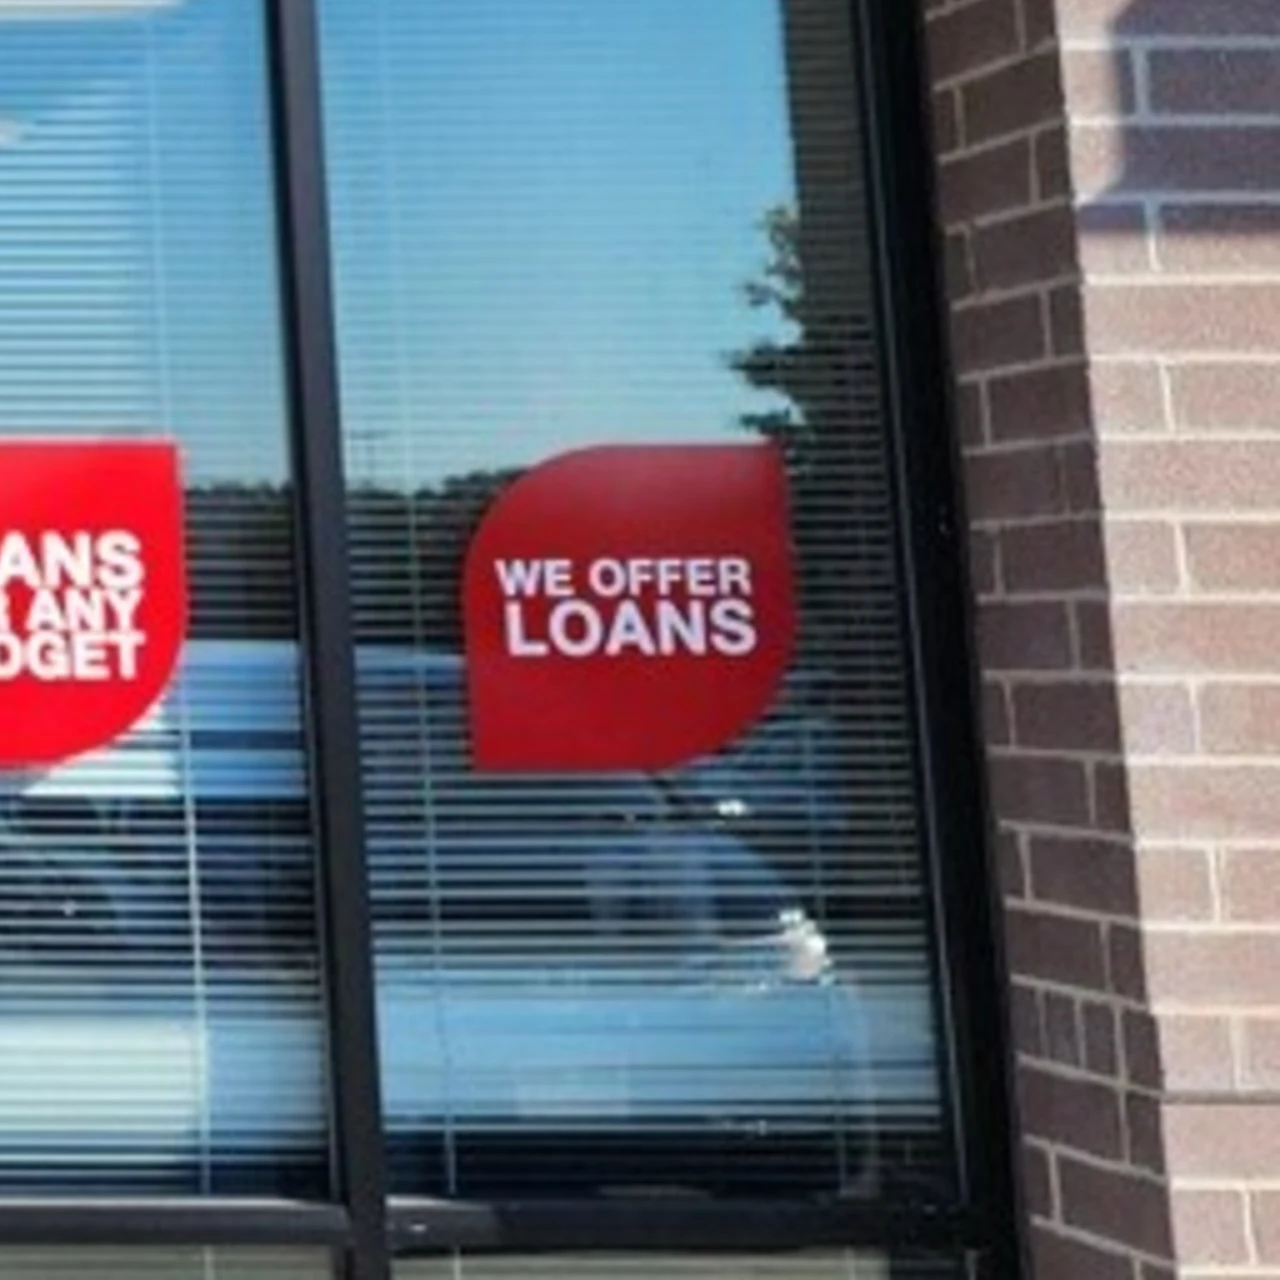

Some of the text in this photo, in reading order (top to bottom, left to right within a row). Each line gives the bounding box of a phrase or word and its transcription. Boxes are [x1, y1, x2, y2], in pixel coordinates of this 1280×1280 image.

[495, 557, 752, 597] WE OFFER
[25, 588, 143, 632] ANY
[504, 599, 757, 657] LOANS
